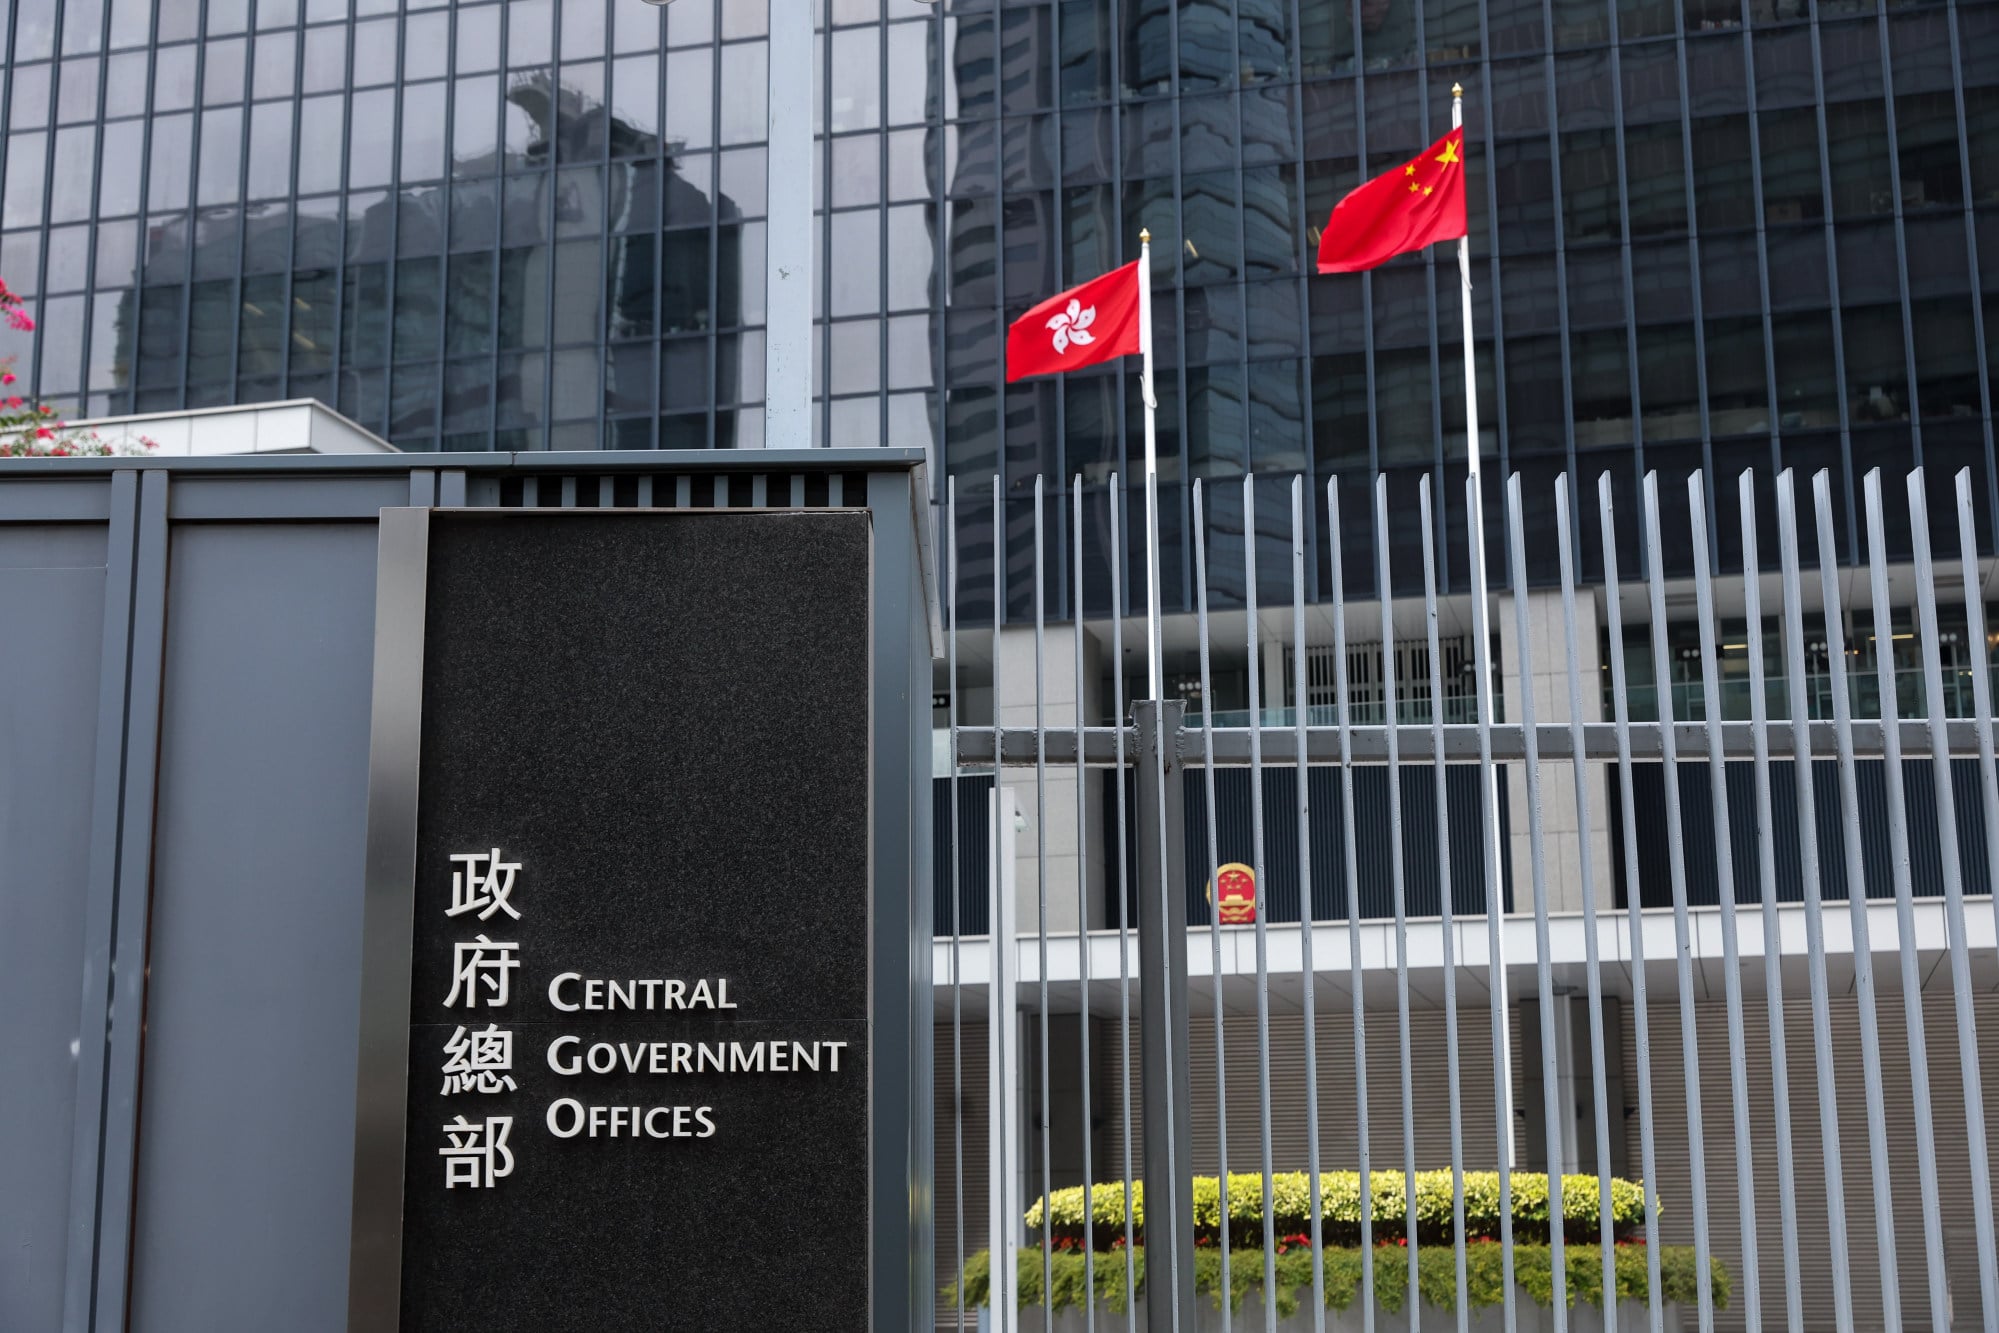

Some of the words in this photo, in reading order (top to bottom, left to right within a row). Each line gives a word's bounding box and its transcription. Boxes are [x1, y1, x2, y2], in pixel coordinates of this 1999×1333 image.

[547, 972, 738, 1012] CENTRAL
[439, 847, 523, 1189] 政府總部
[546, 1035, 848, 1076] GOVERNMENT
[546, 1097, 716, 1139] OFFICES
